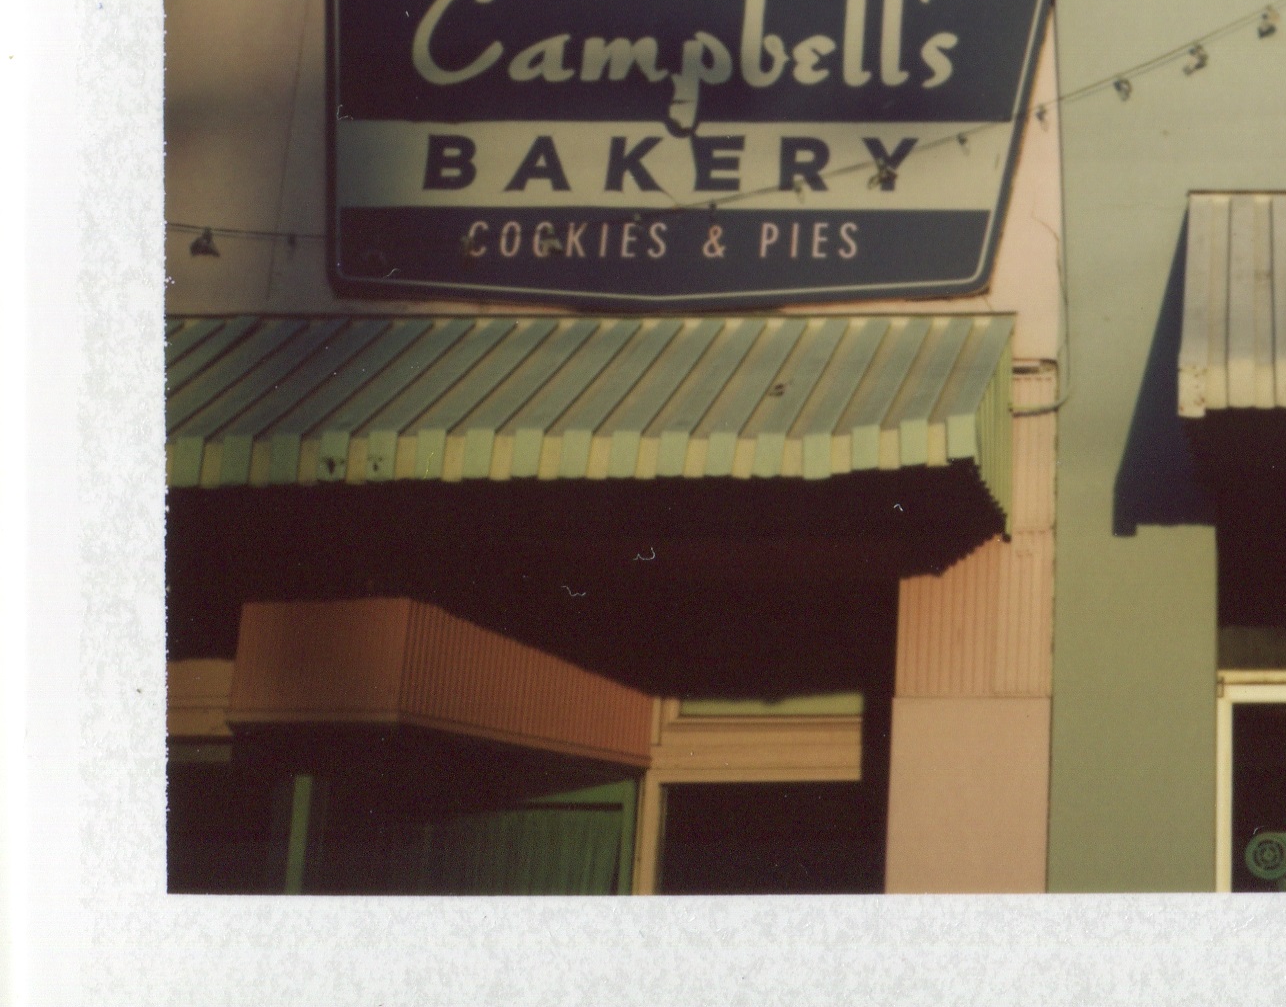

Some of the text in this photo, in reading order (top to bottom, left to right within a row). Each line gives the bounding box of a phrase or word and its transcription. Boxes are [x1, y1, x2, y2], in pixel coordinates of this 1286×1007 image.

[421, 135, 919, 193] BAKERY
[466, 220, 860, 260] COOKIES & PIES
